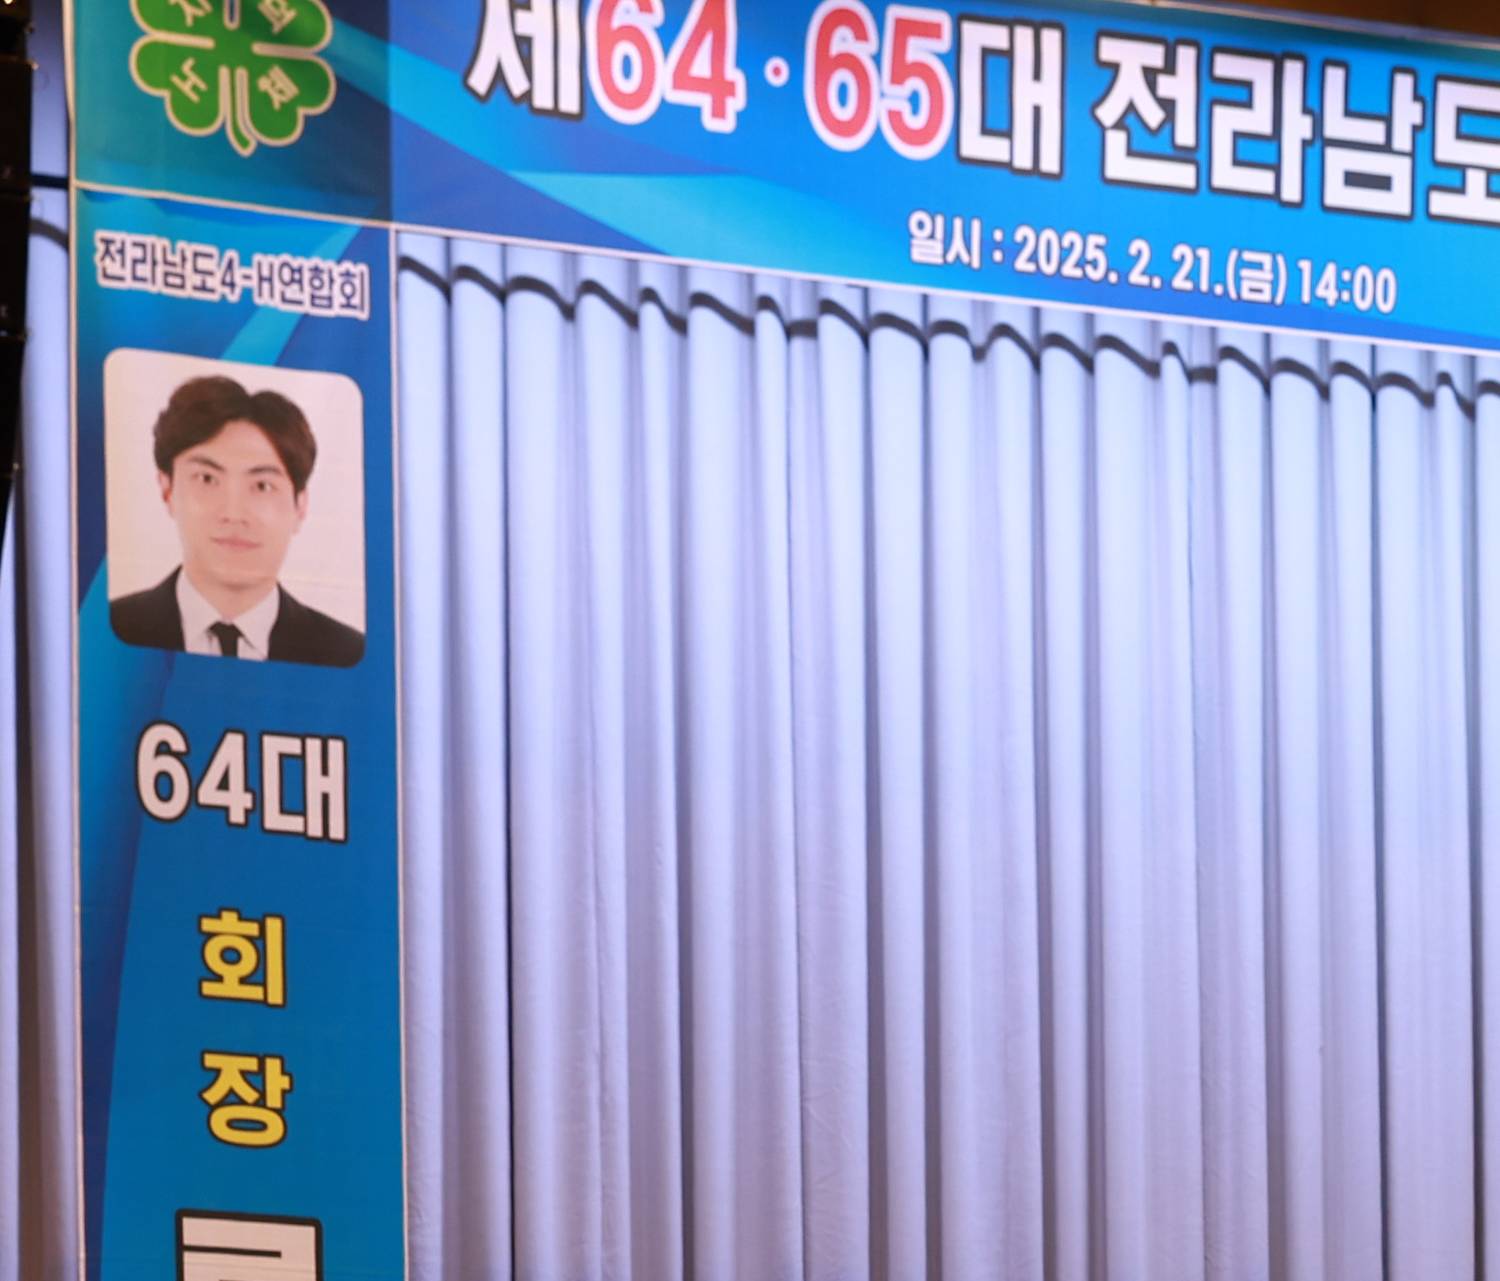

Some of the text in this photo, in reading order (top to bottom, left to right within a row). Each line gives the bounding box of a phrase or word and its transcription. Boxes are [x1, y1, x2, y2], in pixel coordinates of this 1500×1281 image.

[95, 232, 369, 320] 전라남도4-H연합회
[907, 209, 982, 269] 일시
[1013, 225, 1119, 285] 2025.
[1127, 239, 1163, 289] 2.
[1297, 258, 1398, 315] 14:00
[135, 719, 348, 843] 64대
